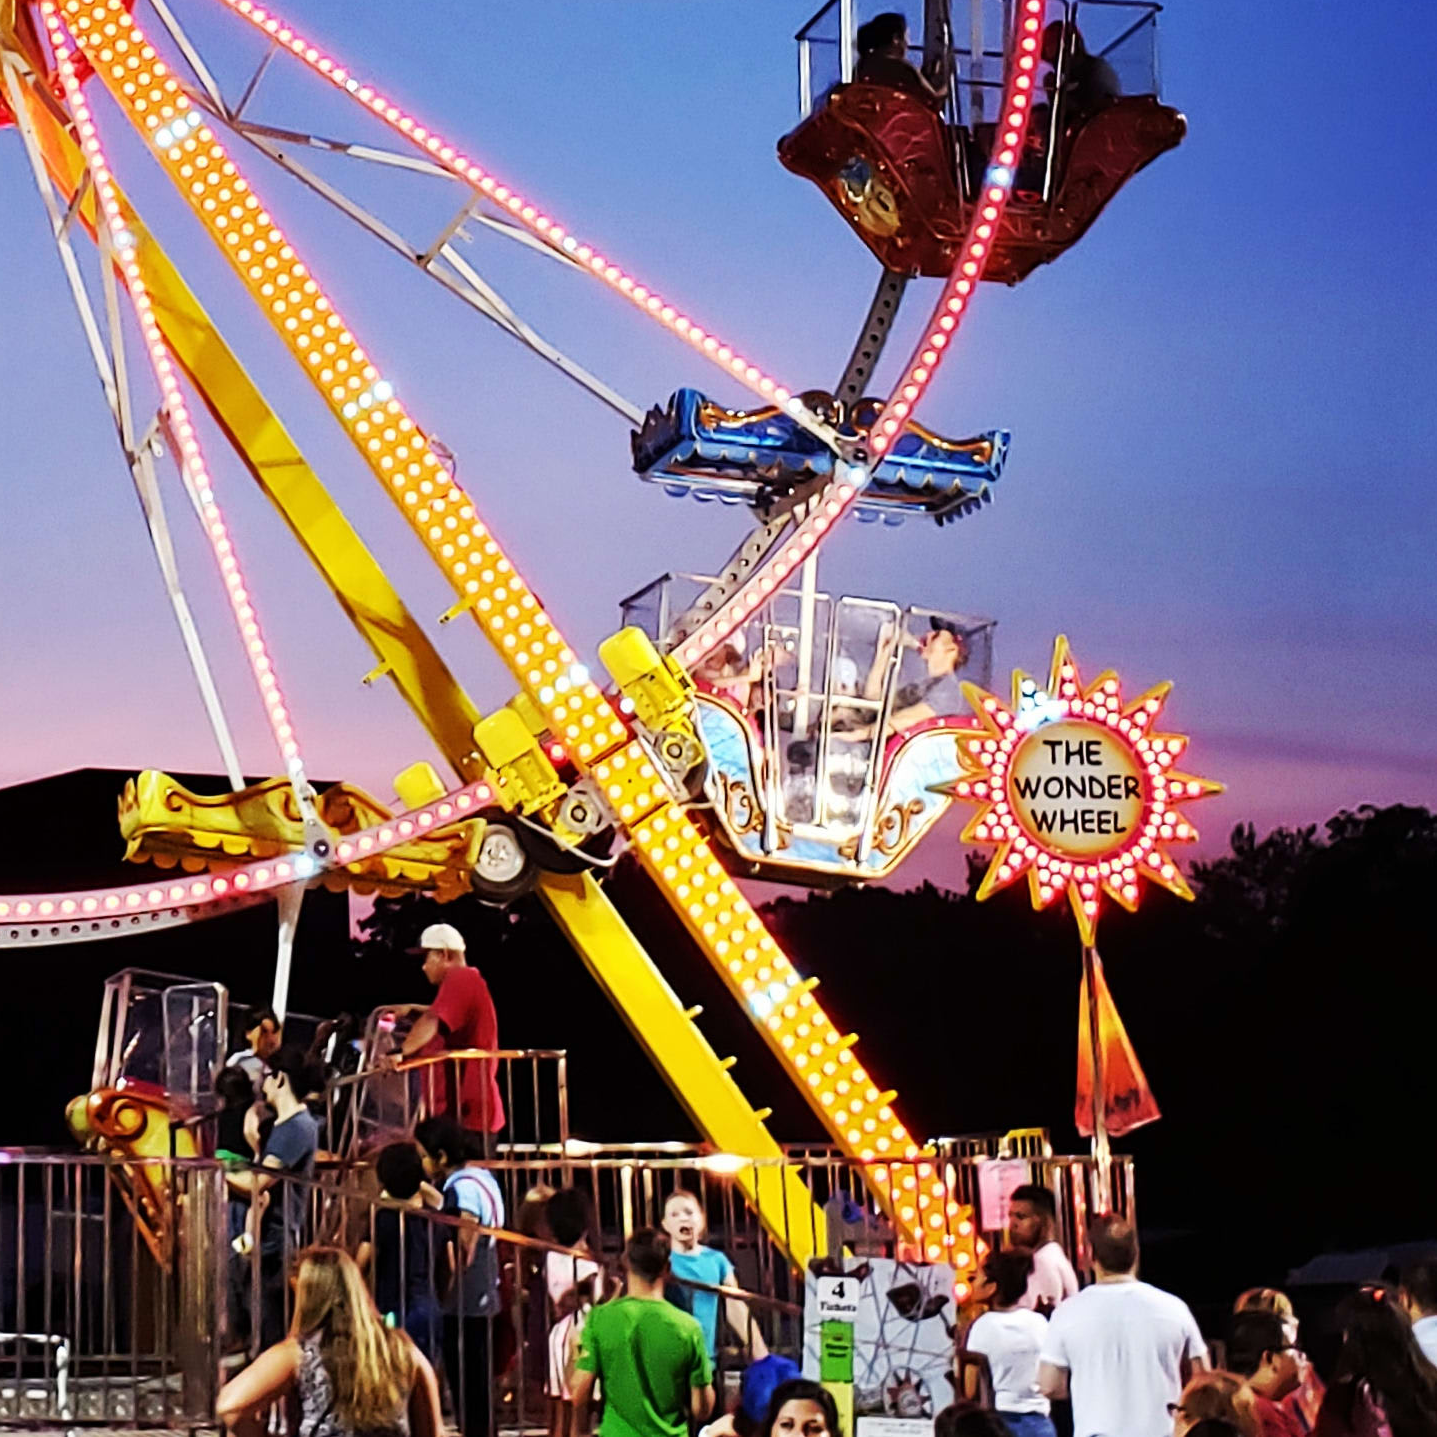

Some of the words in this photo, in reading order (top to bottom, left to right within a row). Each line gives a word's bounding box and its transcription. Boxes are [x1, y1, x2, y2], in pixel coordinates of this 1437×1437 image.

[1042, 739, 1102, 766] THE
[1014, 775, 1142, 800] WONDER
[1031, 809, 1127, 835] WHEEL
[832, 1281, 845, 1299] 4
